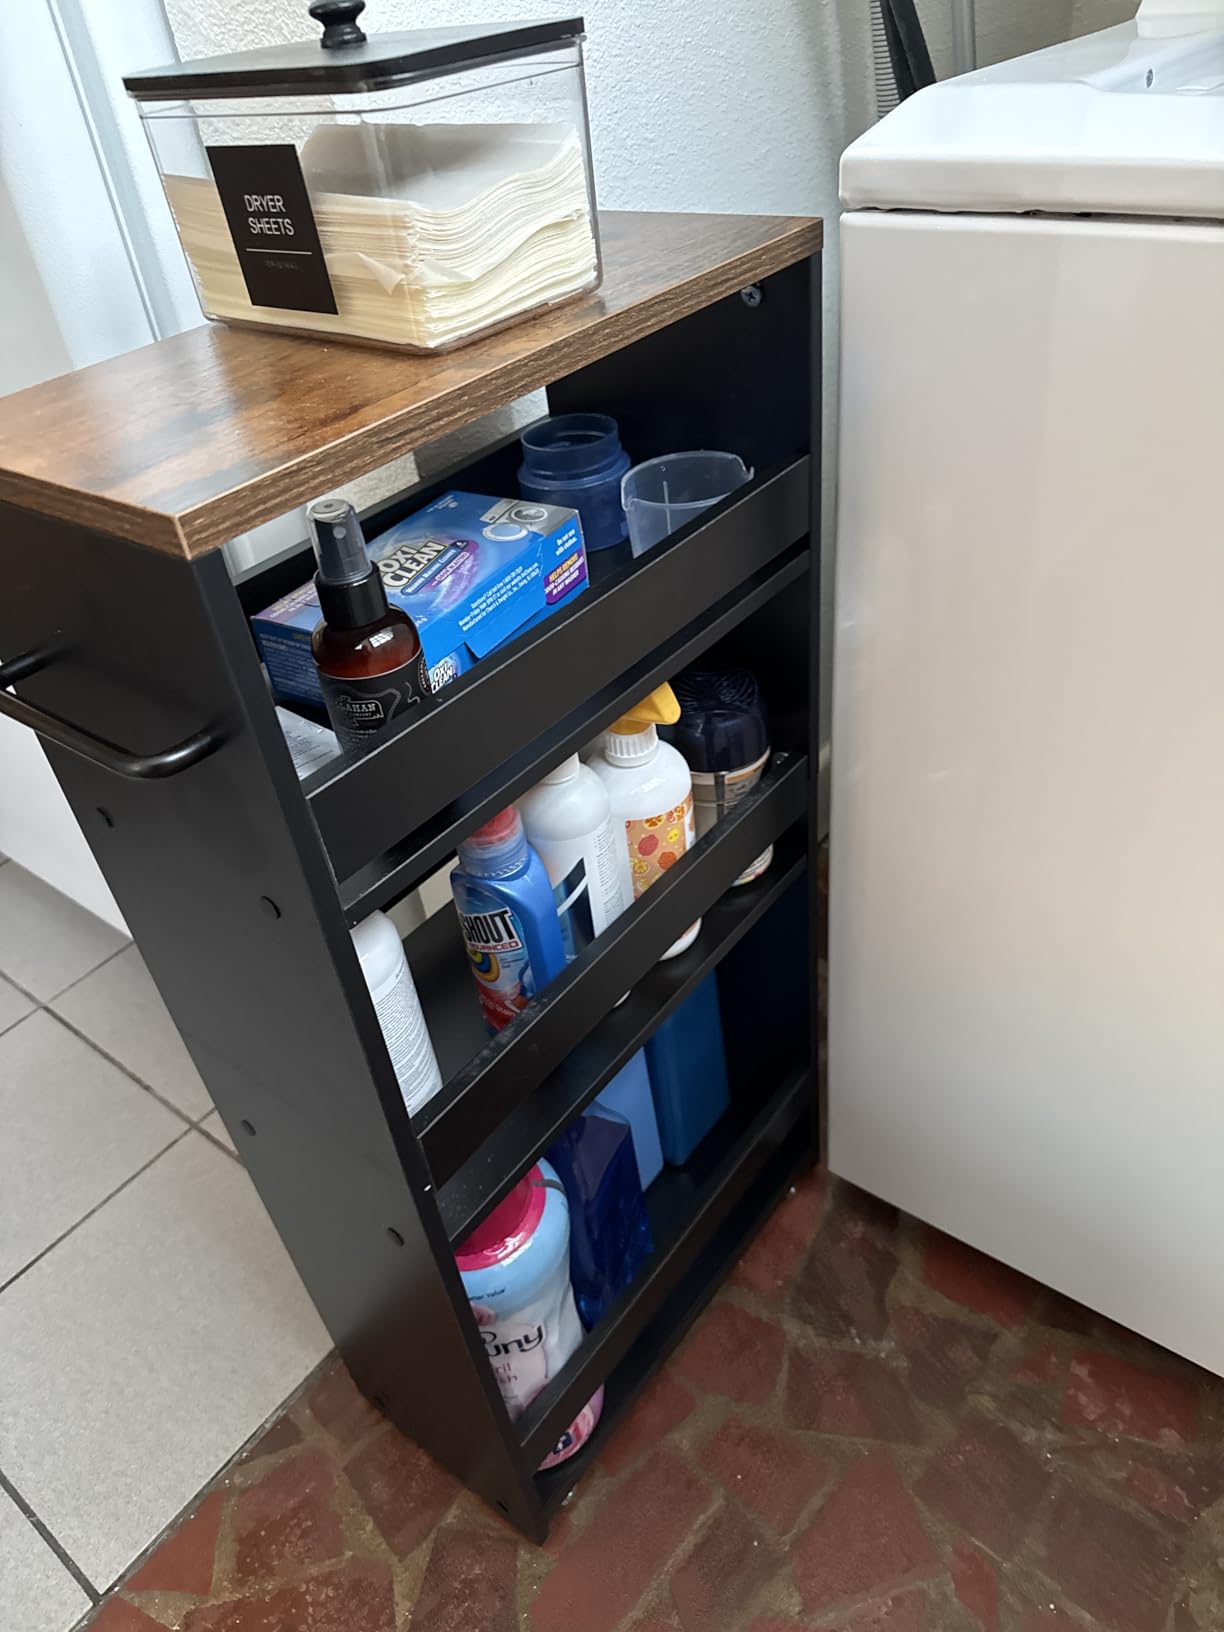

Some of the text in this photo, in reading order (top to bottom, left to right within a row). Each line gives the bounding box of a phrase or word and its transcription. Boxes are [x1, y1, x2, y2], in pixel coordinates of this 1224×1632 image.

[243, 194, 286, 212] DRYER
[248, 217, 295, 236] SHEETS
[379, 545, 418, 573] OXI
[383, 541, 446, 587] CLEAN
[431, 666, 453, 694] CLEAN
[433, 662, 448, 682] OXI
[463, 910, 515, 944] SHOUT
